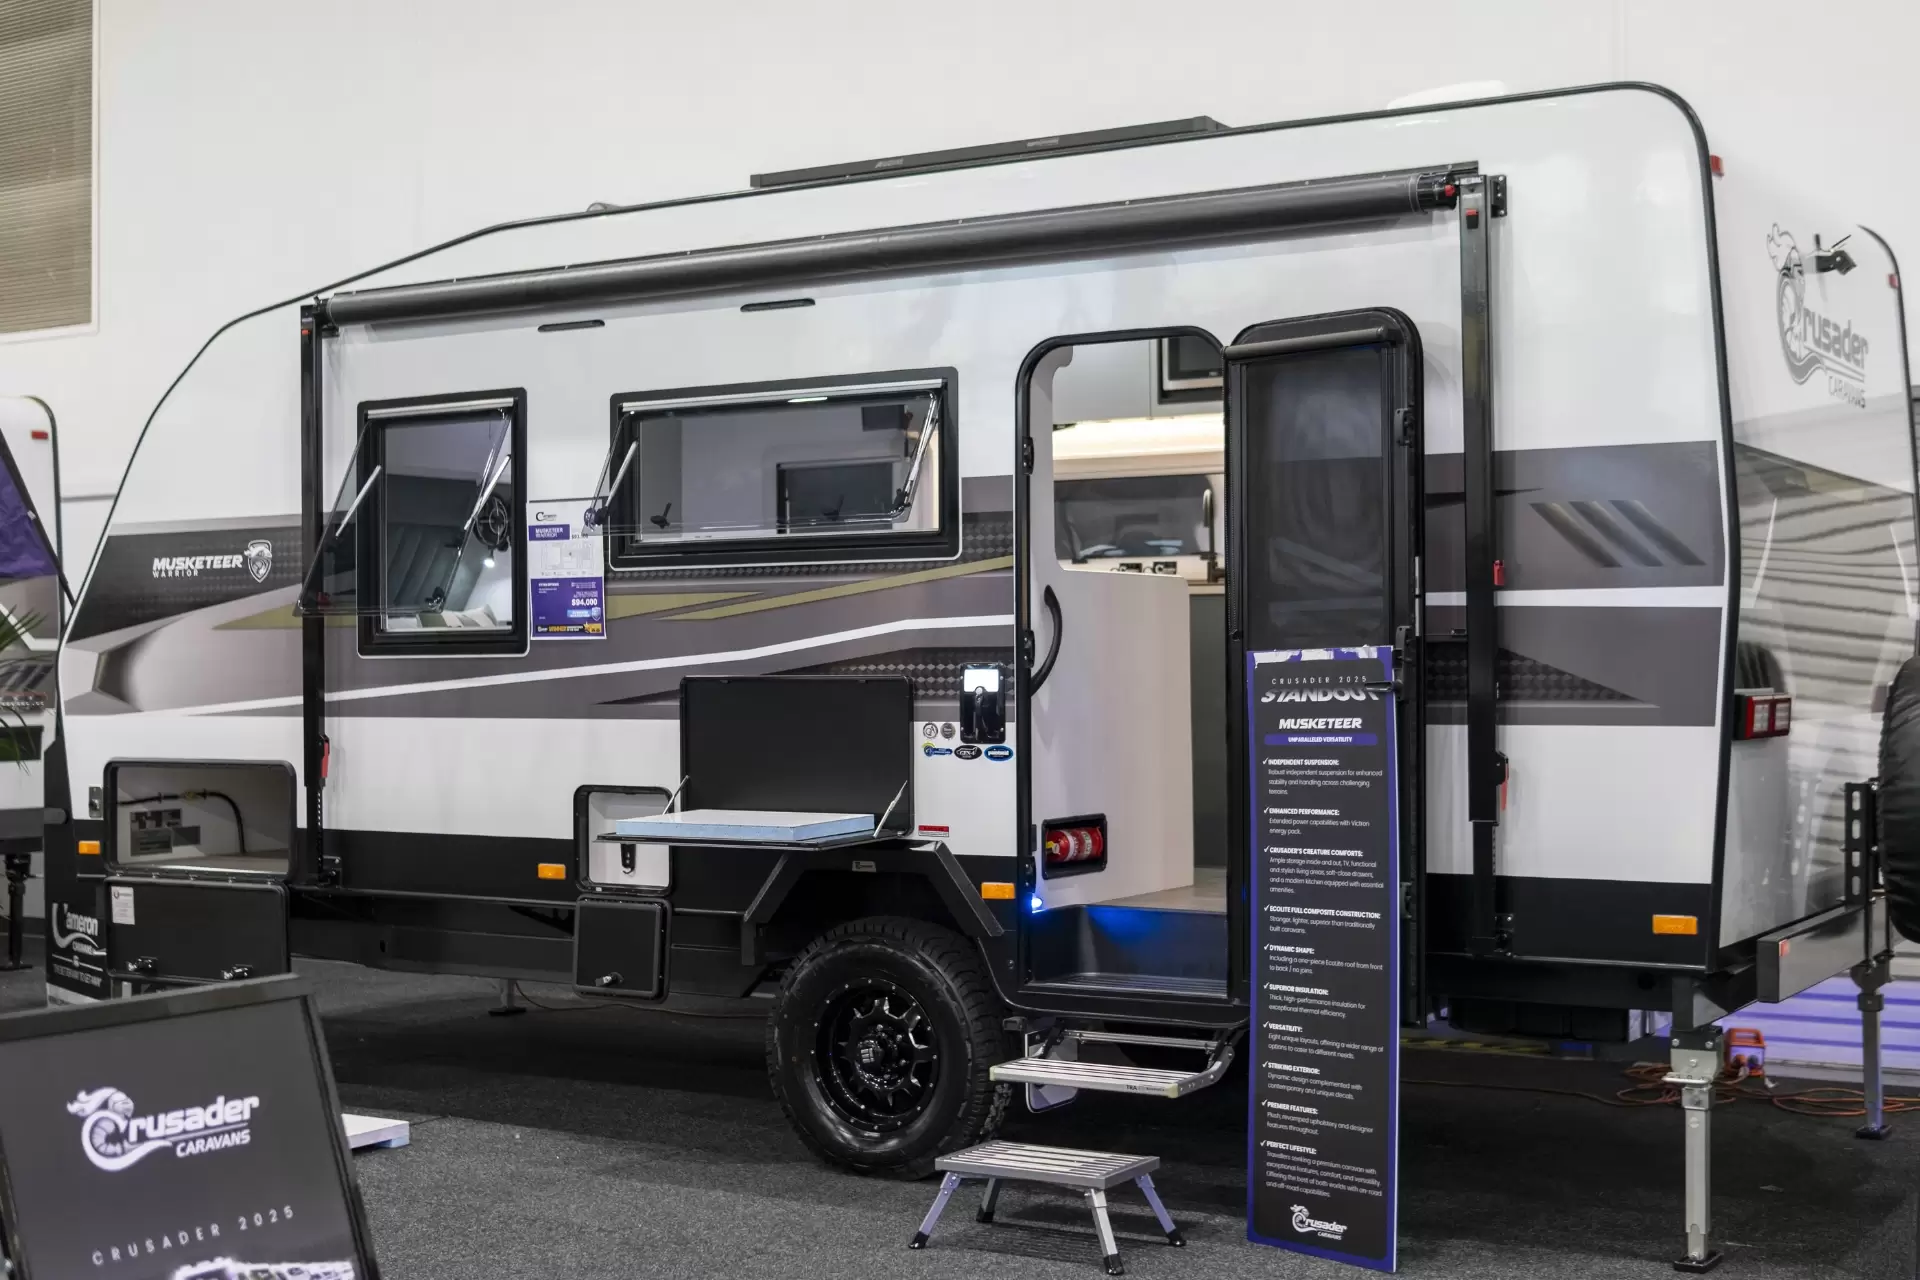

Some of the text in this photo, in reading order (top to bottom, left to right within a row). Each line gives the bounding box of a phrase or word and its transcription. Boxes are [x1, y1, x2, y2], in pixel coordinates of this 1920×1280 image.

[152, 555, 243, 570] MUSKETEER
[152, 570, 199, 578] WARRIOR
[572, 598, 597, 606] $94,000
[1279, 717, 1362, 729] MUSKETEER
[1299, 779, 1321, 787] handling
[1340, 780, 1370, 788] challenging
[1286, 858, 1305, 866] storage
[1296, 868, 1309, 876] living
[1270, 905, 1291, 913] ECOLITE
[1304, 907, 1334, 916] COMPOSITE
[1345, 921, 1375, 930] traditionally
[1270, 944, 1315, 954] DYNAMIC SHAPE:
[1270, 955, 1292, 963] Including
[1270, 984, 1294, 992] SUPERIOR
[1332, 999, 1357, 1008] insulation
[1269, 1004, 1298, 1012] exceptional
[1299, 1006, 1319, 1014] thermal
[1268, 1033, 1280, 1041] Eight
[1320, 1040, 1340, 1048] offering
[1361, 1045, 1377, 1053] range
[1268, 1062, 1292, 1071] STRIKING
[1268, 1072, 1290, 1081] Dynamic
[1291, 1076, 1308, 1084] design
[1310, 1078, 1350, 1089] complemented
[1268, 1083, 1304, 1093] contemporary
[1267, 1102, 1289, 1110] PREMIER
[1267, 1122, 1288, 1130] features
[1282, 1114, 1309, 1124] revamped
[1310, 1119, 1337, 1129] upholstery
[1350, 1124, 1373, 1133] designer
[82, 1096, 260, 1172] Crusader
[176, 1129, 250, 1157] CARAVANS
[1267, 1141, 1288, 1150] PERFECT
[1266, 1161, 1296, 1171] exceptional
[1292, 1156, 1311, 1164] seeking
[1316, 1160, 1341, 1169] premium
[1342, 1164, 1364, 1173] caravan
[1266, 1170, 1287, 1180] Offering
[1297, 1176, 1308, 1184] best
[1316, 1179, 1328, 1187] both
[1292, 1212, 1347, 1233] Crusader
[92, 1204, 294, 1266] CRUSADER 2025
[1318, 1231, 1342, 1240] CARAVANS
